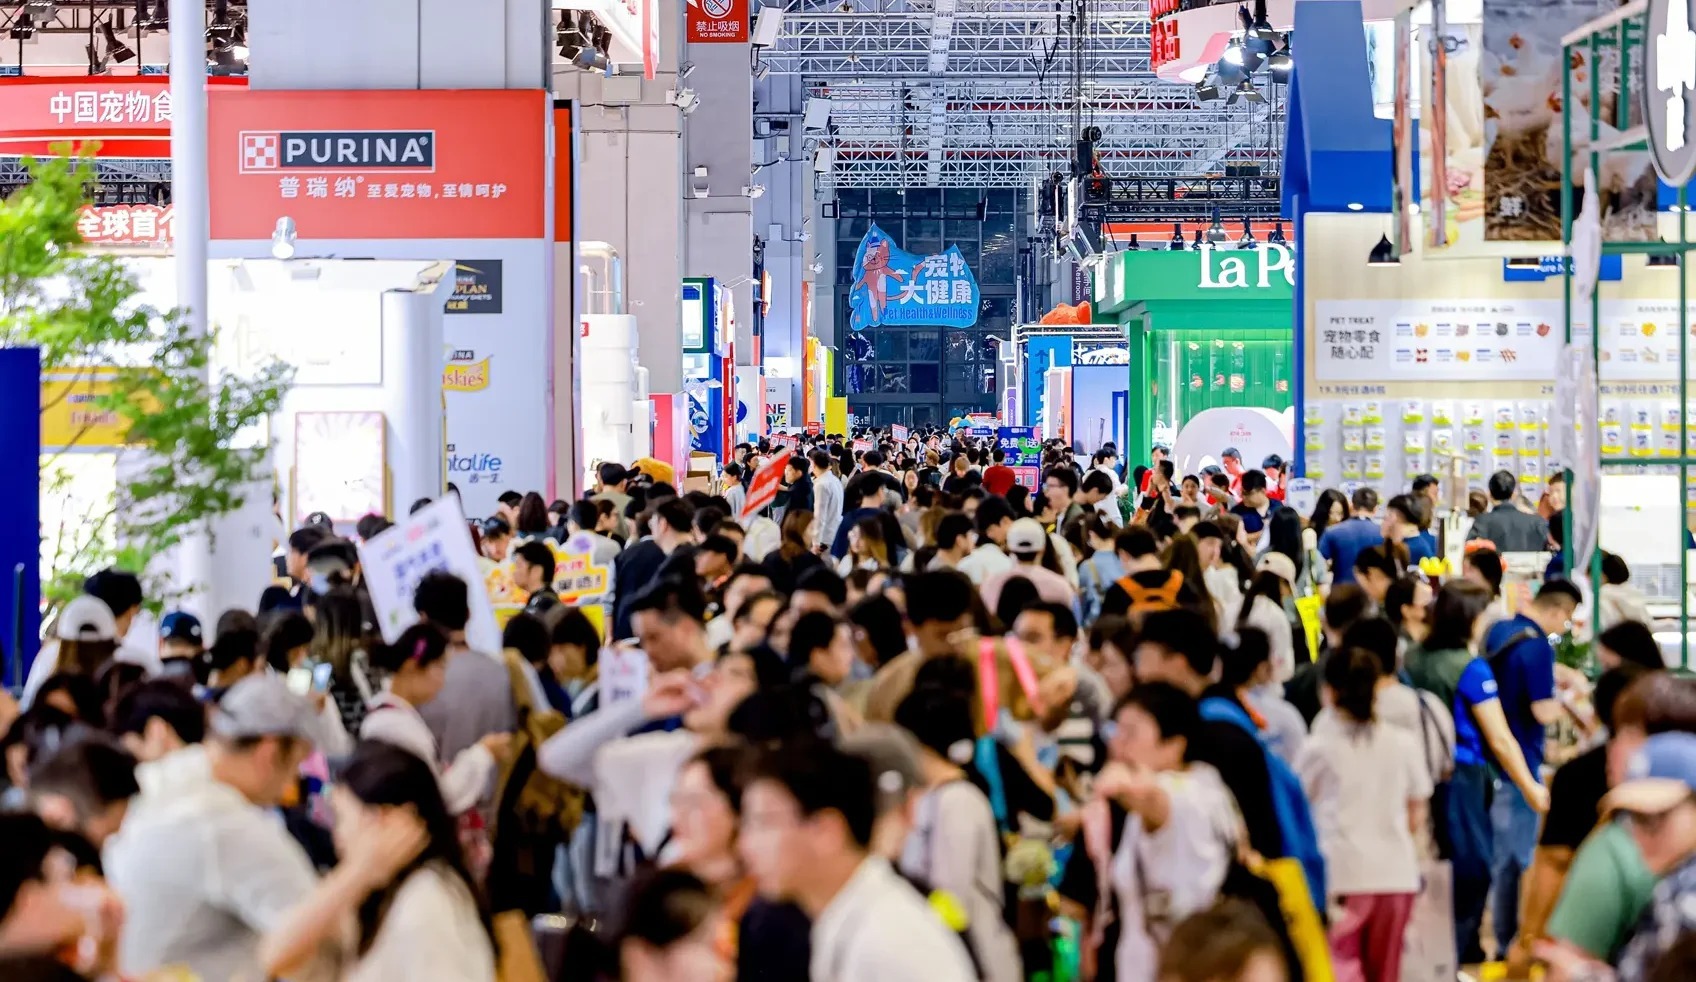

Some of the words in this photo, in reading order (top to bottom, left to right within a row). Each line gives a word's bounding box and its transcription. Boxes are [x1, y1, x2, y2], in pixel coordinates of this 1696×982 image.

[696, 21, 740, 31] 禁止吸烟
[50, 90, 173, 123] 中国宠物食
[1197, 243, 1249, 288] La
[900, 280, 972, 304] 大健康
